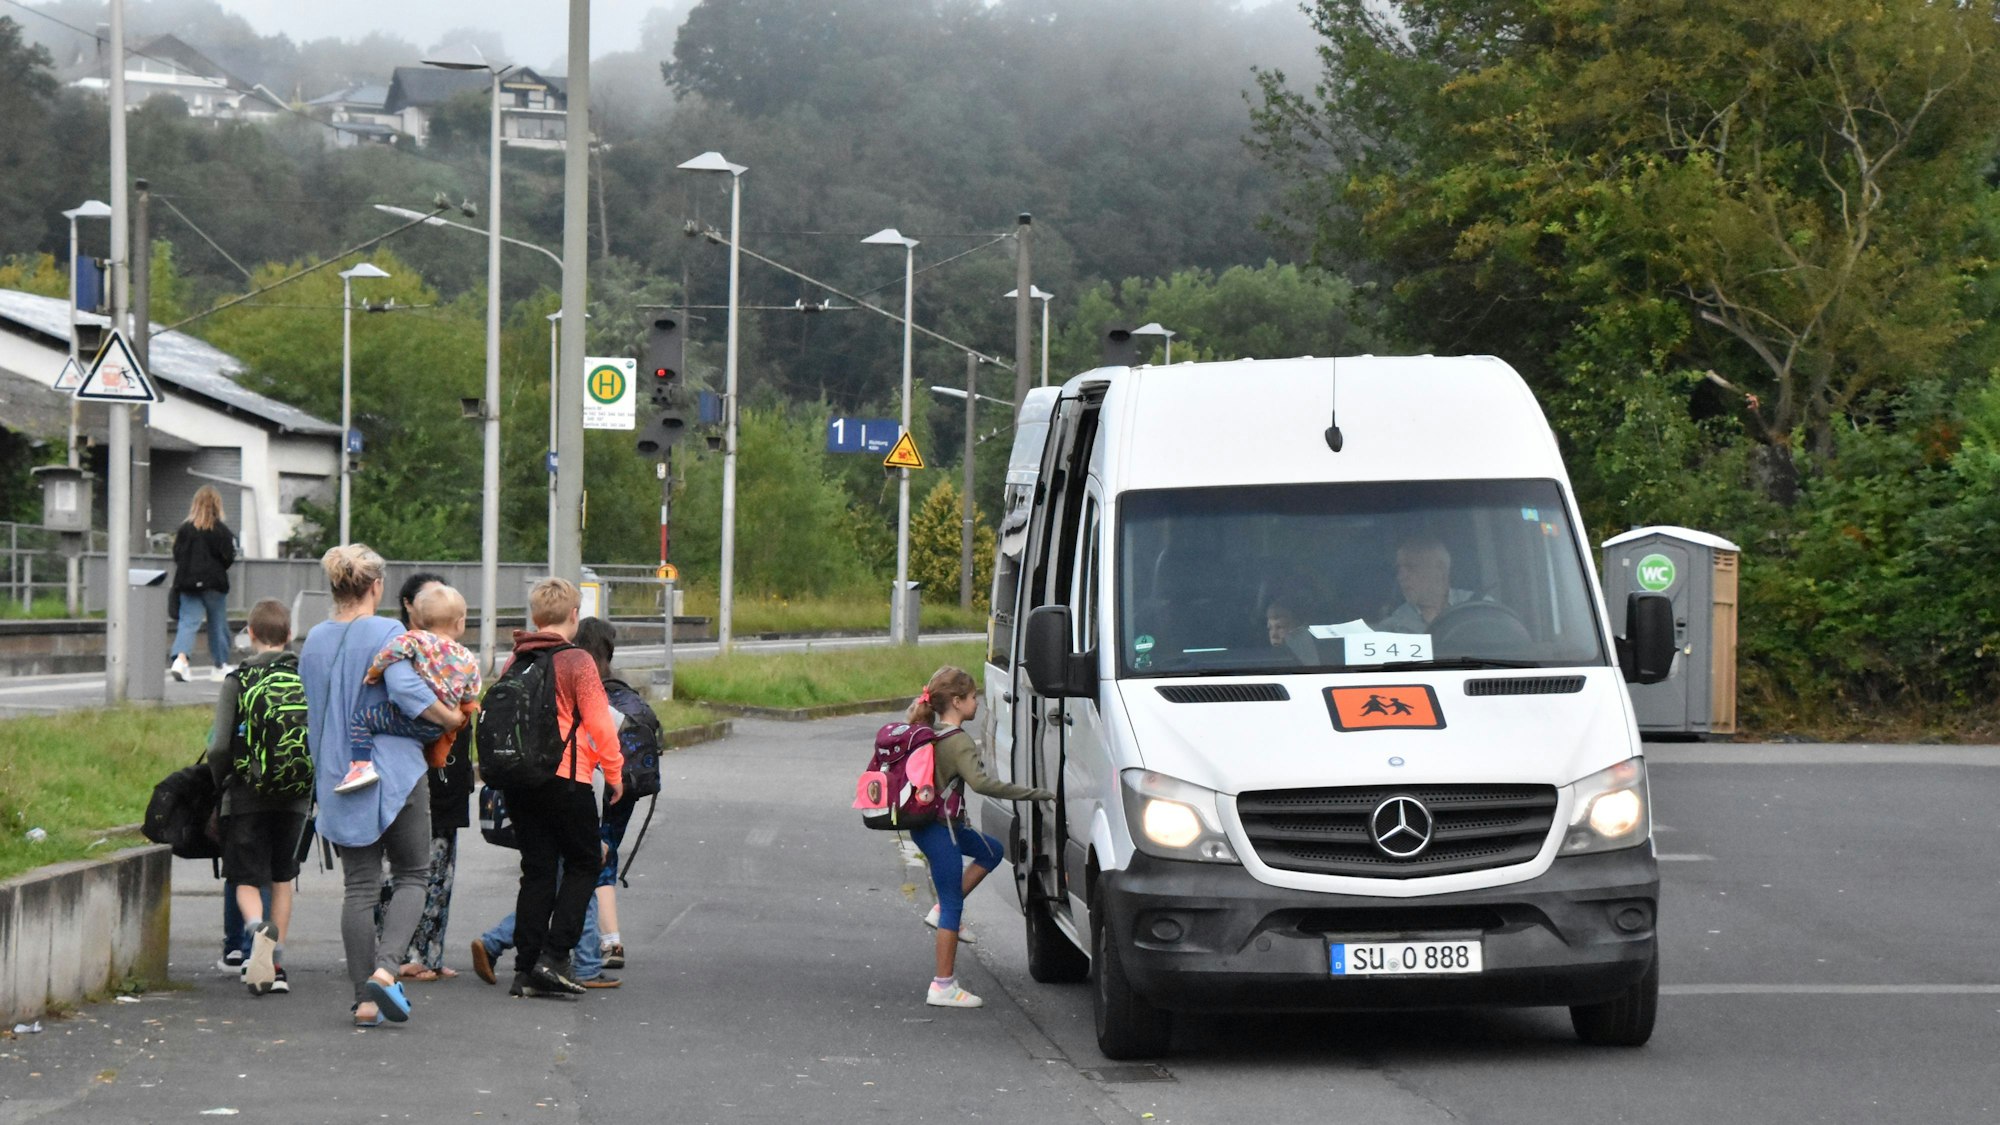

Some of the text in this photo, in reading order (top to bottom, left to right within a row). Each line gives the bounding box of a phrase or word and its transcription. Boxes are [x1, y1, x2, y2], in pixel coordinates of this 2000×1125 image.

[599, 373, 614, 395] H
[832, 418, 844, 444] 1
[1642, 567, 1669, 581] WC
[1353, 948, 1384, 970] SU
[1425, 945, 1469, 969] 888
